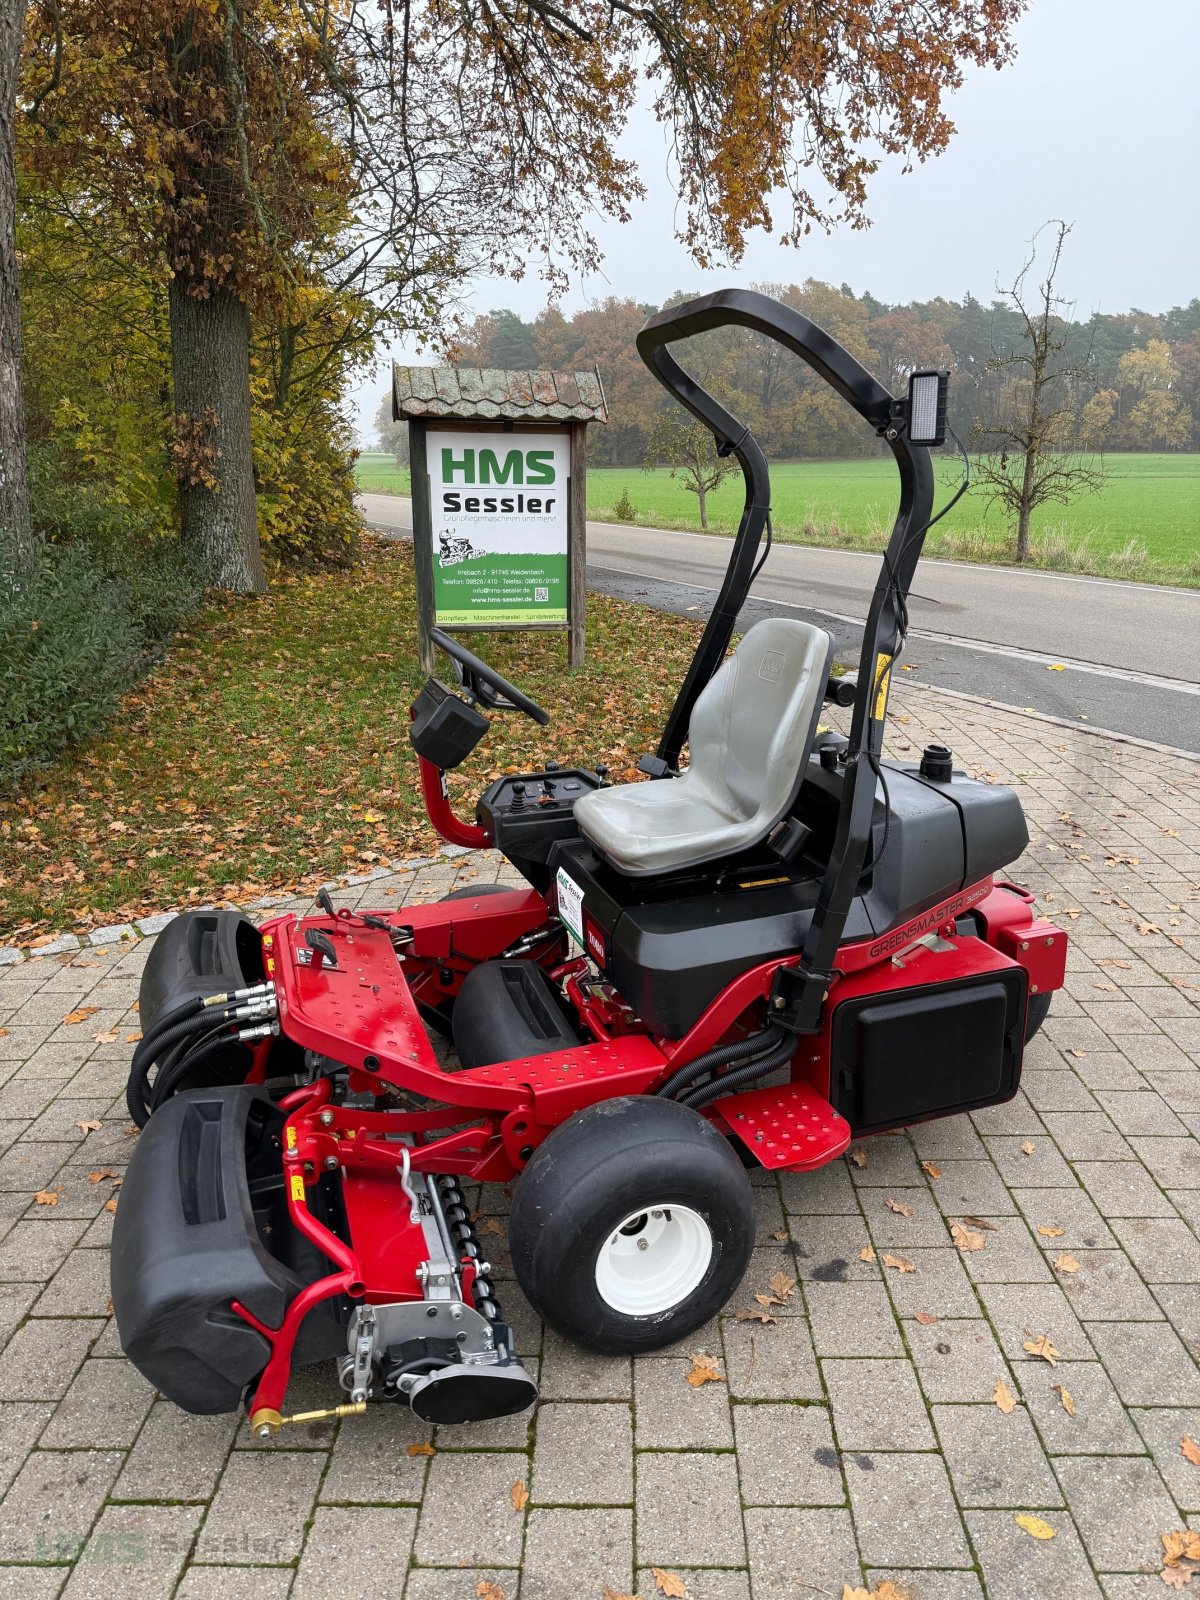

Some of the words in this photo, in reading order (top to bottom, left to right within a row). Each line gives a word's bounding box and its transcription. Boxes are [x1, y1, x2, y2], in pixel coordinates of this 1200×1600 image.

[441, 448, 556, 485] HMS
[443, 492, 556, 513] Sessler
[443, 514, 521, 523] Grünpflegemaschinen
[568, 883, 582, 900] Sessler
[869, 896, 965, 958] GREENSMASTER
